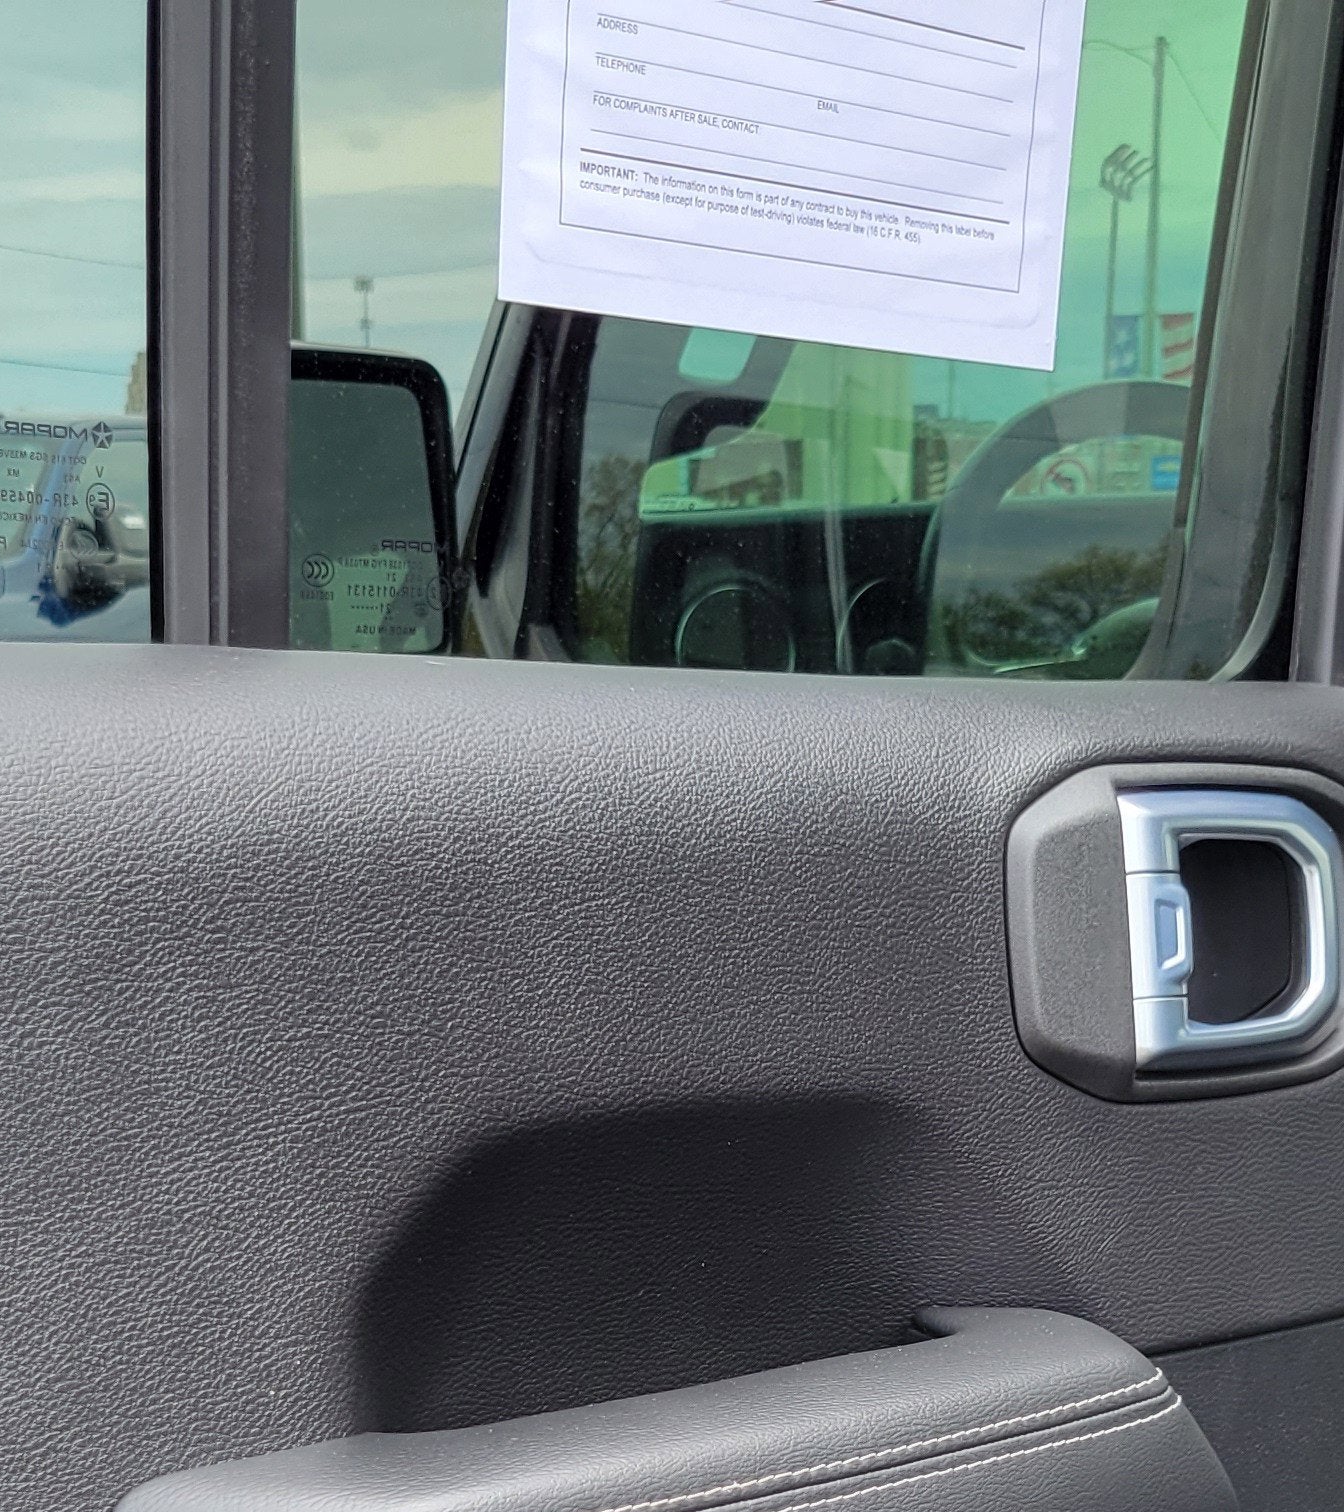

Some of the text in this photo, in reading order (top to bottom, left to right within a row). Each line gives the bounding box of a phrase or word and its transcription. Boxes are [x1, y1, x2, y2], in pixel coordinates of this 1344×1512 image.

[597, 17, 638, 35] ADDRESS
[596, 56, 646, 75] TELEPHONE
[593, 94, 612, 107] FOR
[613, 98, 668, 118] COMPLAINTS
[669, 109, 696, 122] AFTER
[721, 119, 760, 134] CONTACT
[817, 100, 840, 114] EMAIL
[579, 161, 638, 182] IMPORTANT:
[643, 172, 660, 186] The
[661, 174, 706, 193] information
[708, 185, 718, 194] on
[720, 184, 735, 198] this
[736, 187, 754, 201] form
[756, 190, 762, 202] is
[764, 194, 780, 206] part
[780, 196, 790, 207] of
[790, 199, 805, 211] any
[805, 200, 836, 215] contract
[836, 204, 844, 216] to
[845, 206, 859, 220] buy
[860, 210, 873, 221] this
[904, 216, 940, 234] Removing
[941, 222, 954, 233] this
[972, 227, 995, 241] before
[579, 179, 622, 194] consumer
[622, 184, 660, 202] purchase
[662, 191, 693, 208] (except
[694, 195, 706, 208] for
[707, 200, 739, 214] purpose
[740, 203, 750, 216] of
[796, 216, 825, 228] violates
[826, 218, 852, 232] federal
